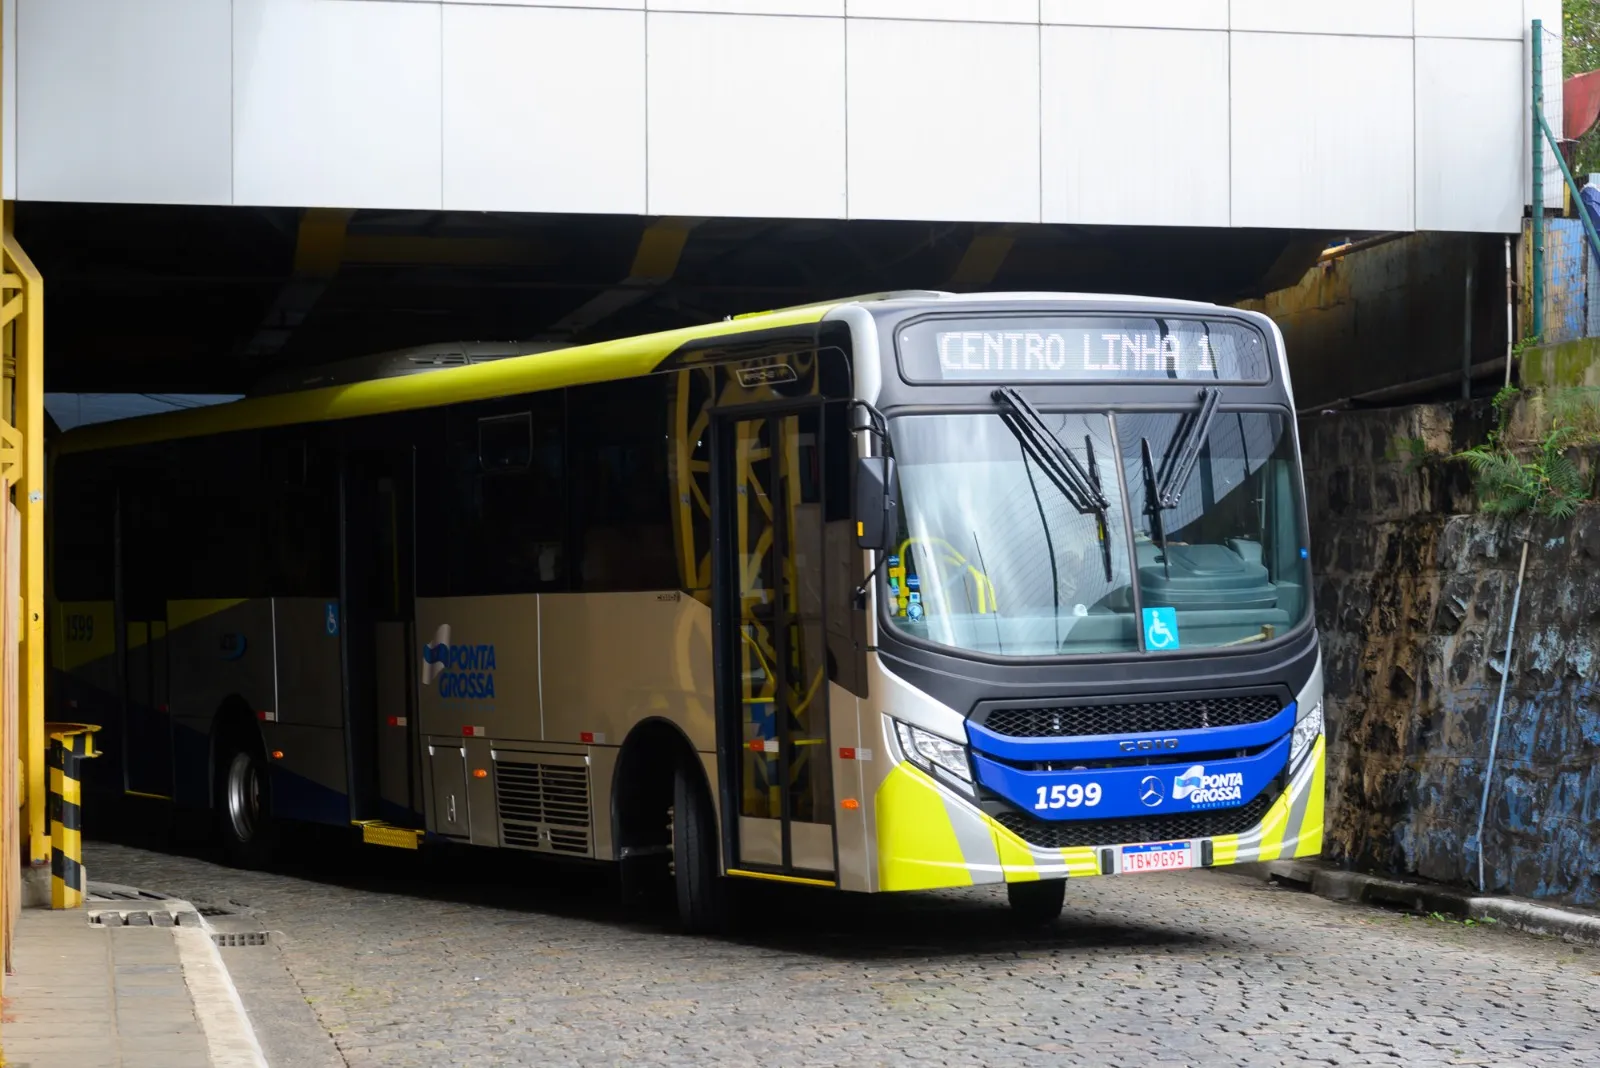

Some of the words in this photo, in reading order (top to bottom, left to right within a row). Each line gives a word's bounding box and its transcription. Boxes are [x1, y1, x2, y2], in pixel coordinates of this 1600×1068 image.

[941, 332, 1066, 371] CENTRO
[1083, 333, 1181, 371] LINHA
[1197, 335, 1215, 371] 1
[66, 613, 94, 642] 1599
[447, 644, 496, 670] PONTA
[439, 672, 495, 698] GROSSA
[1201, 772, 1244, 789] PONTA
[1034, 782, 1102, 810] 1599
[1190, 785, 1242, 803] GROSSA
[1128, 850, 1184, 869] TBW9G95
